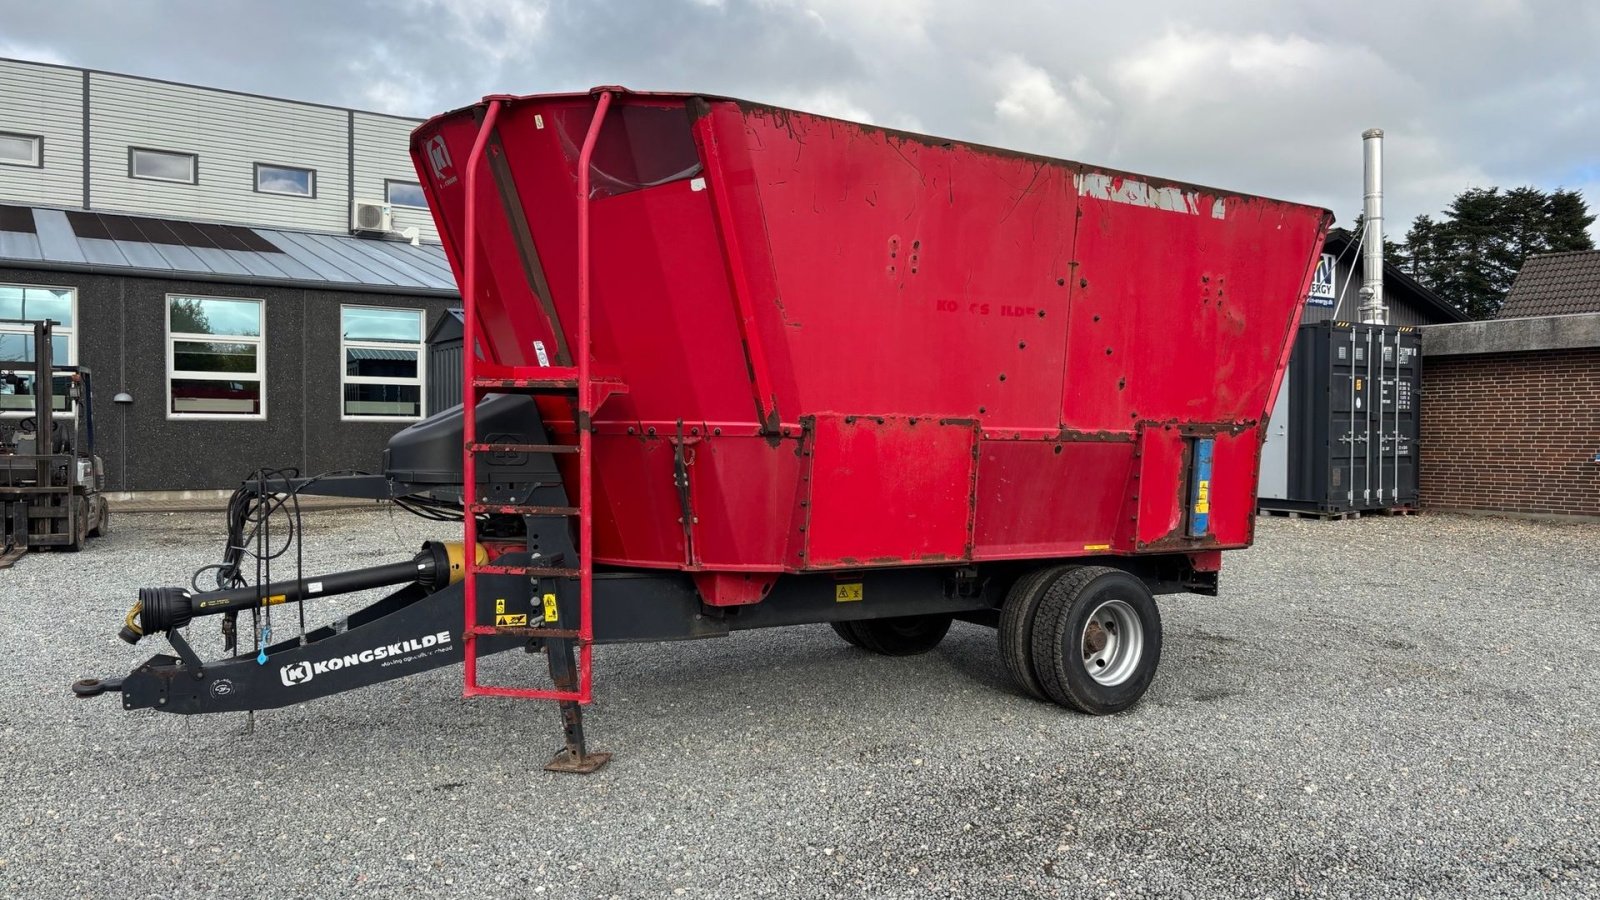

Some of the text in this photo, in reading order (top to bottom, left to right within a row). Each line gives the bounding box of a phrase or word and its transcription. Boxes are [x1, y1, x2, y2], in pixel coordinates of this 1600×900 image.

[1311, 284, 1331, 295] ERGY
[937, 300, 1036, 317] KOGSILDE
[315, 631, 451, 674] KONGSKILDE
